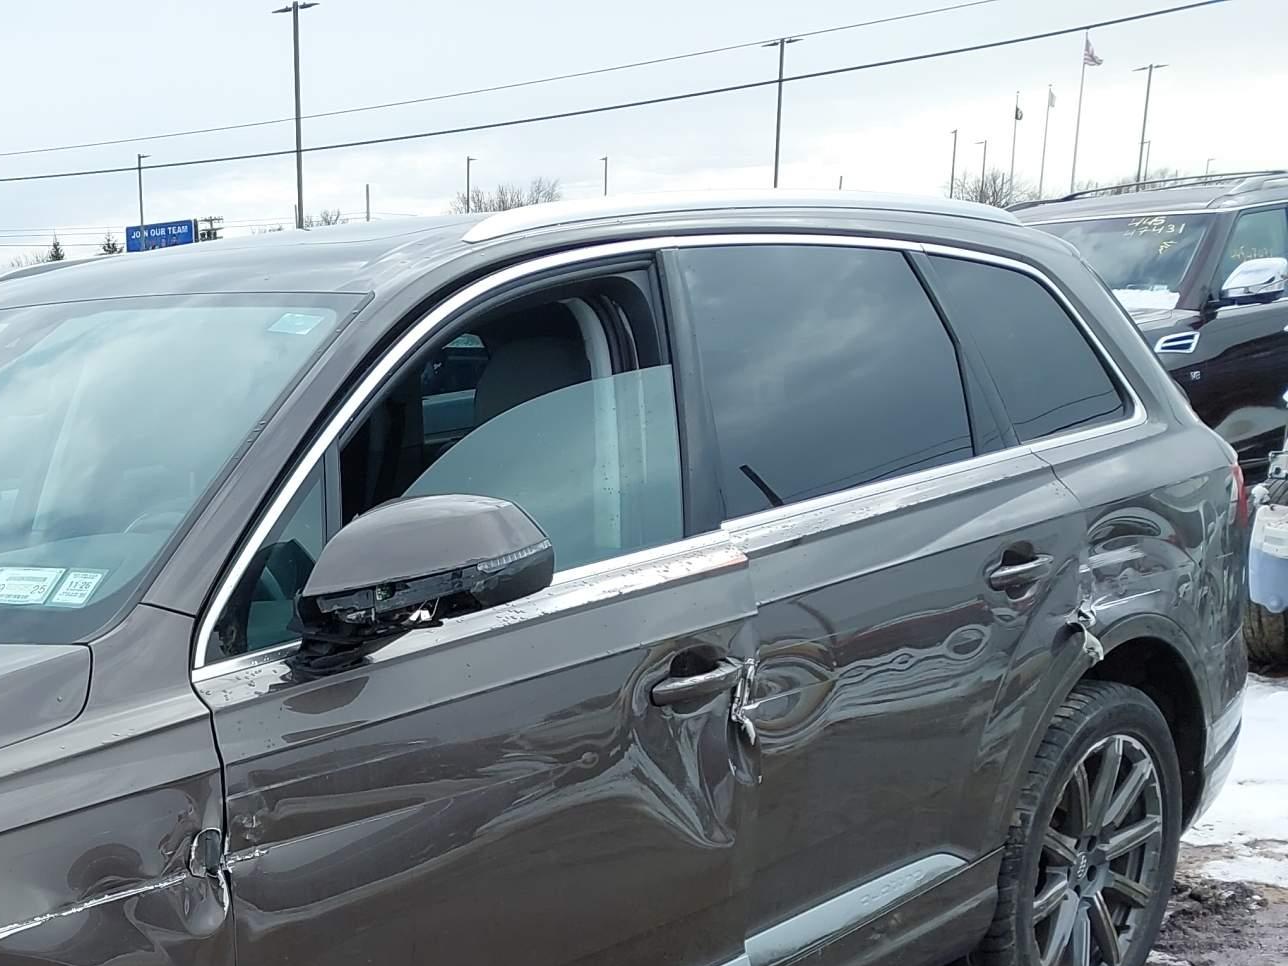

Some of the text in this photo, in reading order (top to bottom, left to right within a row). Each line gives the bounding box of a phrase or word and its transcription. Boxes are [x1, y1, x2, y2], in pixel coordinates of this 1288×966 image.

[131, 225, 189, 239] JON OUR TEAM
